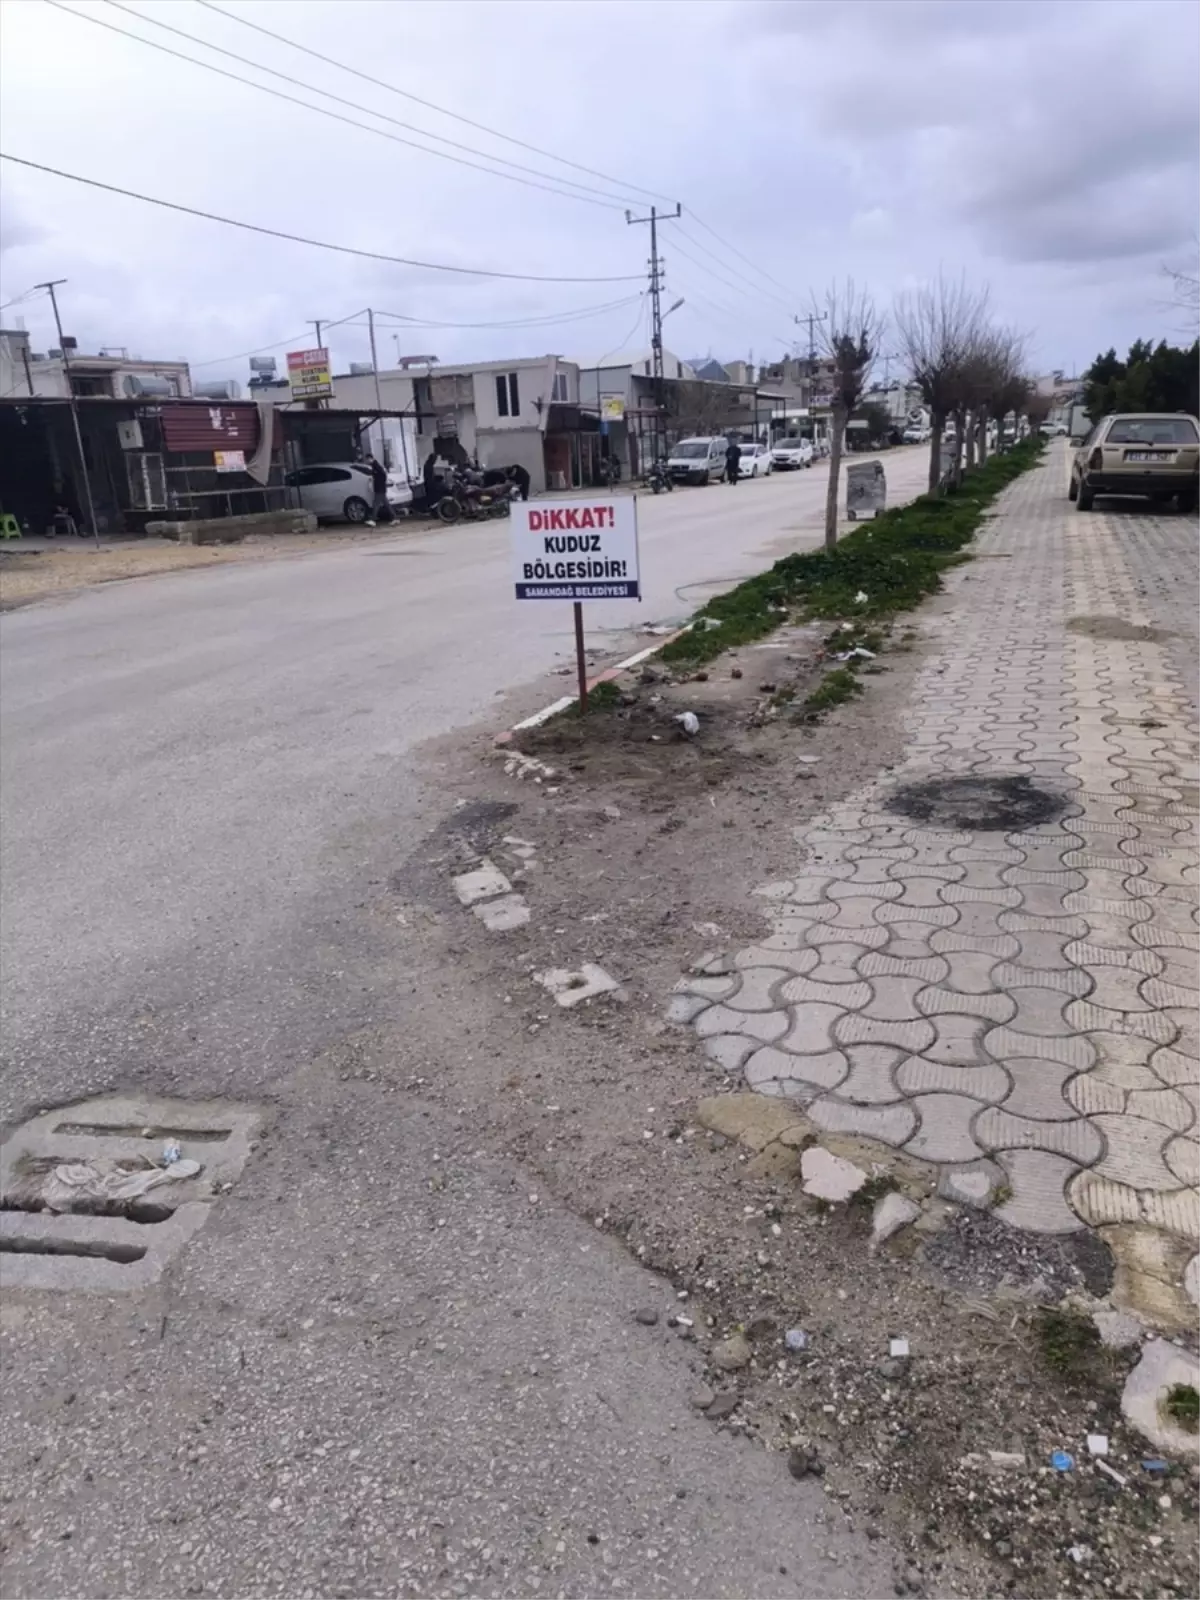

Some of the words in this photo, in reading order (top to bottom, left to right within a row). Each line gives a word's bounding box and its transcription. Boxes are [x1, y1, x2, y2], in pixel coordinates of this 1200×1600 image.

[544, 535, 601, 553] KUDUZ
[523, 557, 627, 579] BÖLGESİDİR!
[525, 585, 574, 597] SAMANDAĞ
[575, 585, 628, 596] BELEDİYESİ
